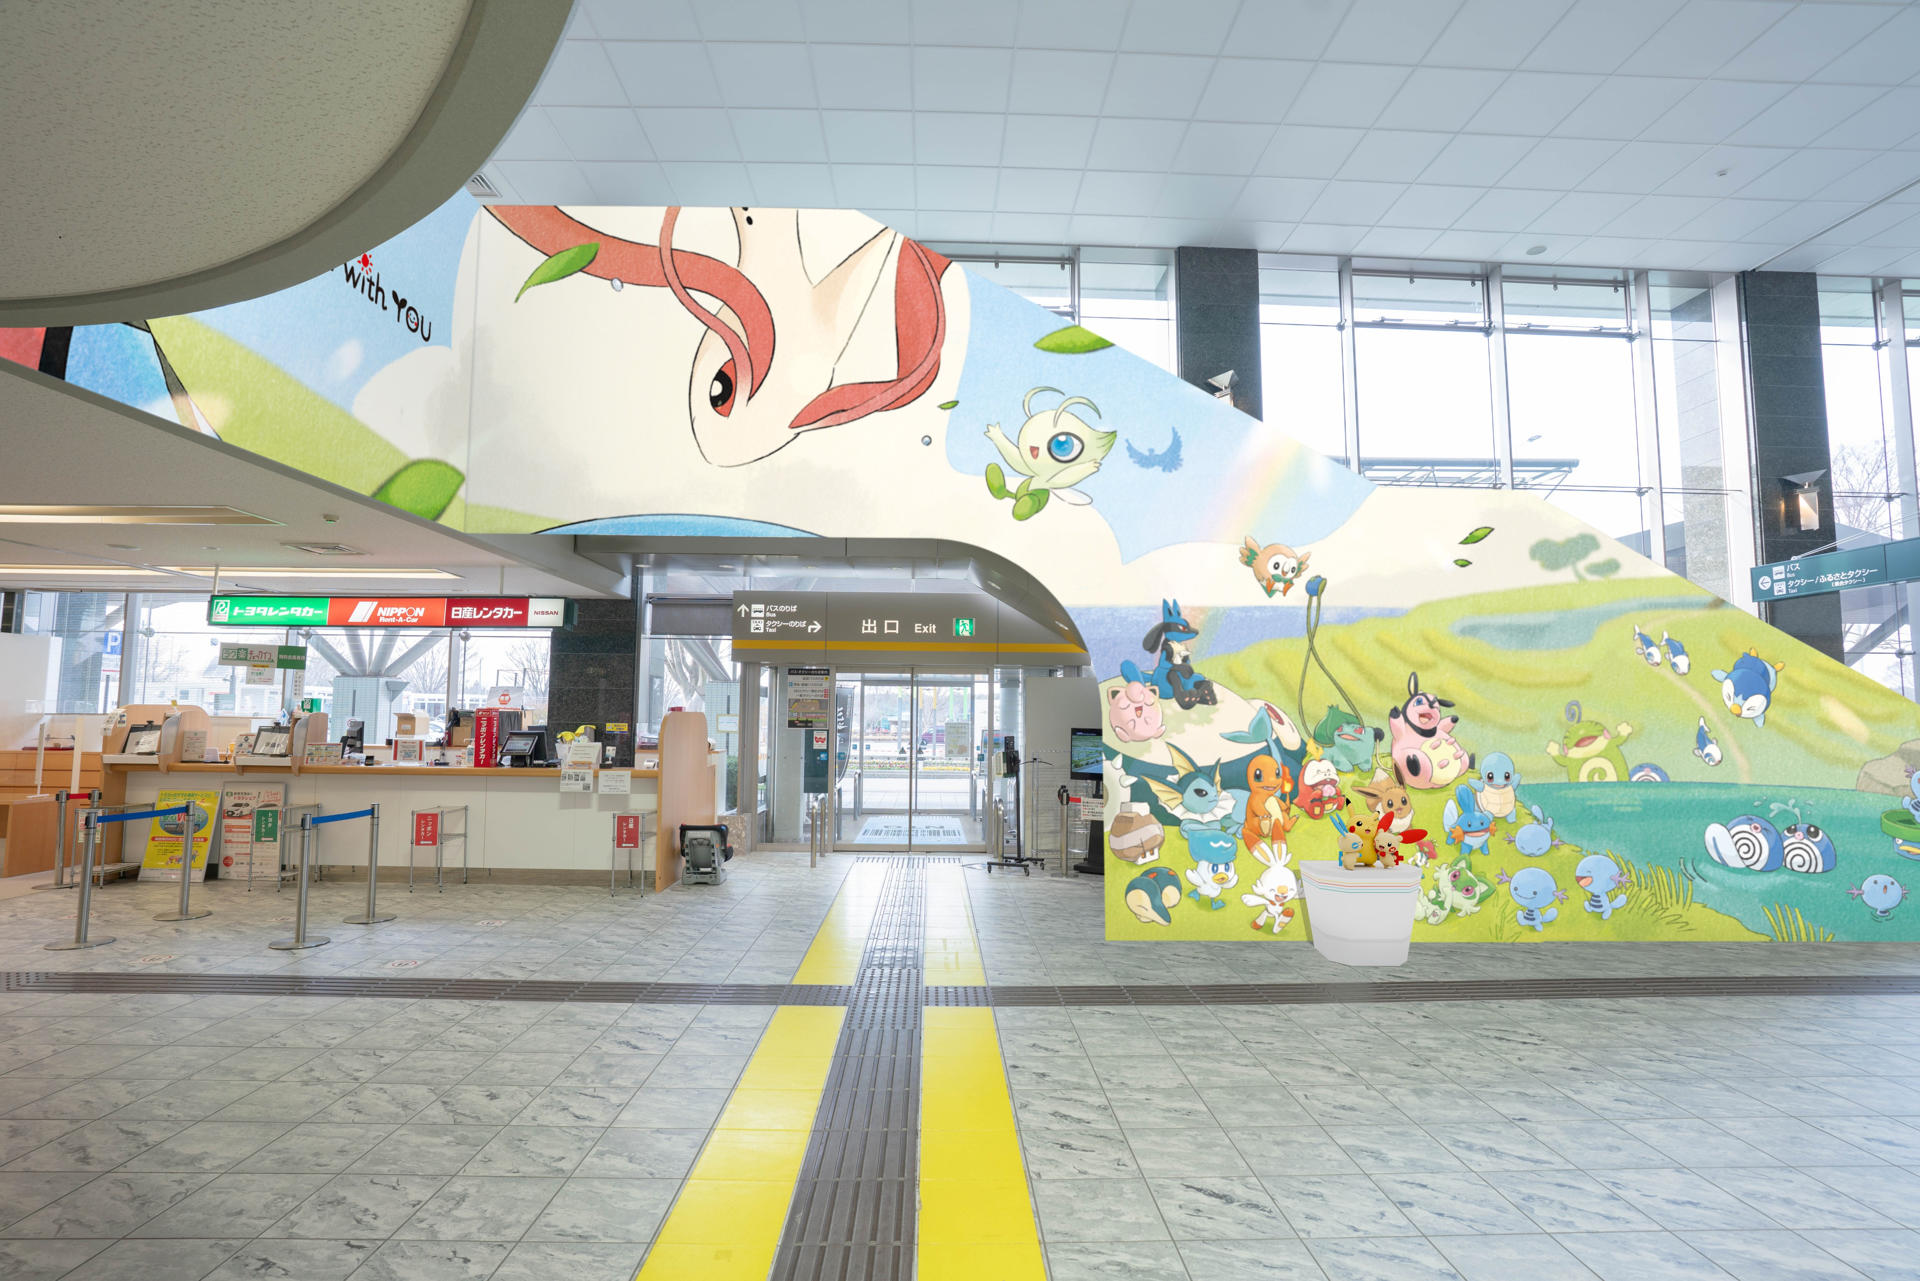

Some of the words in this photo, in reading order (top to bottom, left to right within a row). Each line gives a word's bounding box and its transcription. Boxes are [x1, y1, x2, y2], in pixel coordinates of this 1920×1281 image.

[392, 290, 432, 342] YOU
[1786, 563, 1800, 572] バス
[233, 606, 323, 617] トヨタレンタカー
[377, 606, 425, 617] NIPPON
[451, 607, 523, 619] 日産レンタカー
[765, 620, 807, 628] タクシーのりば
[861, 619, 899, 634] 出口
[914, 623, 937, 634] Exit
[106, 632, 121, 652] P
[479, 717, 487, 765] ニッポンレンタカー
